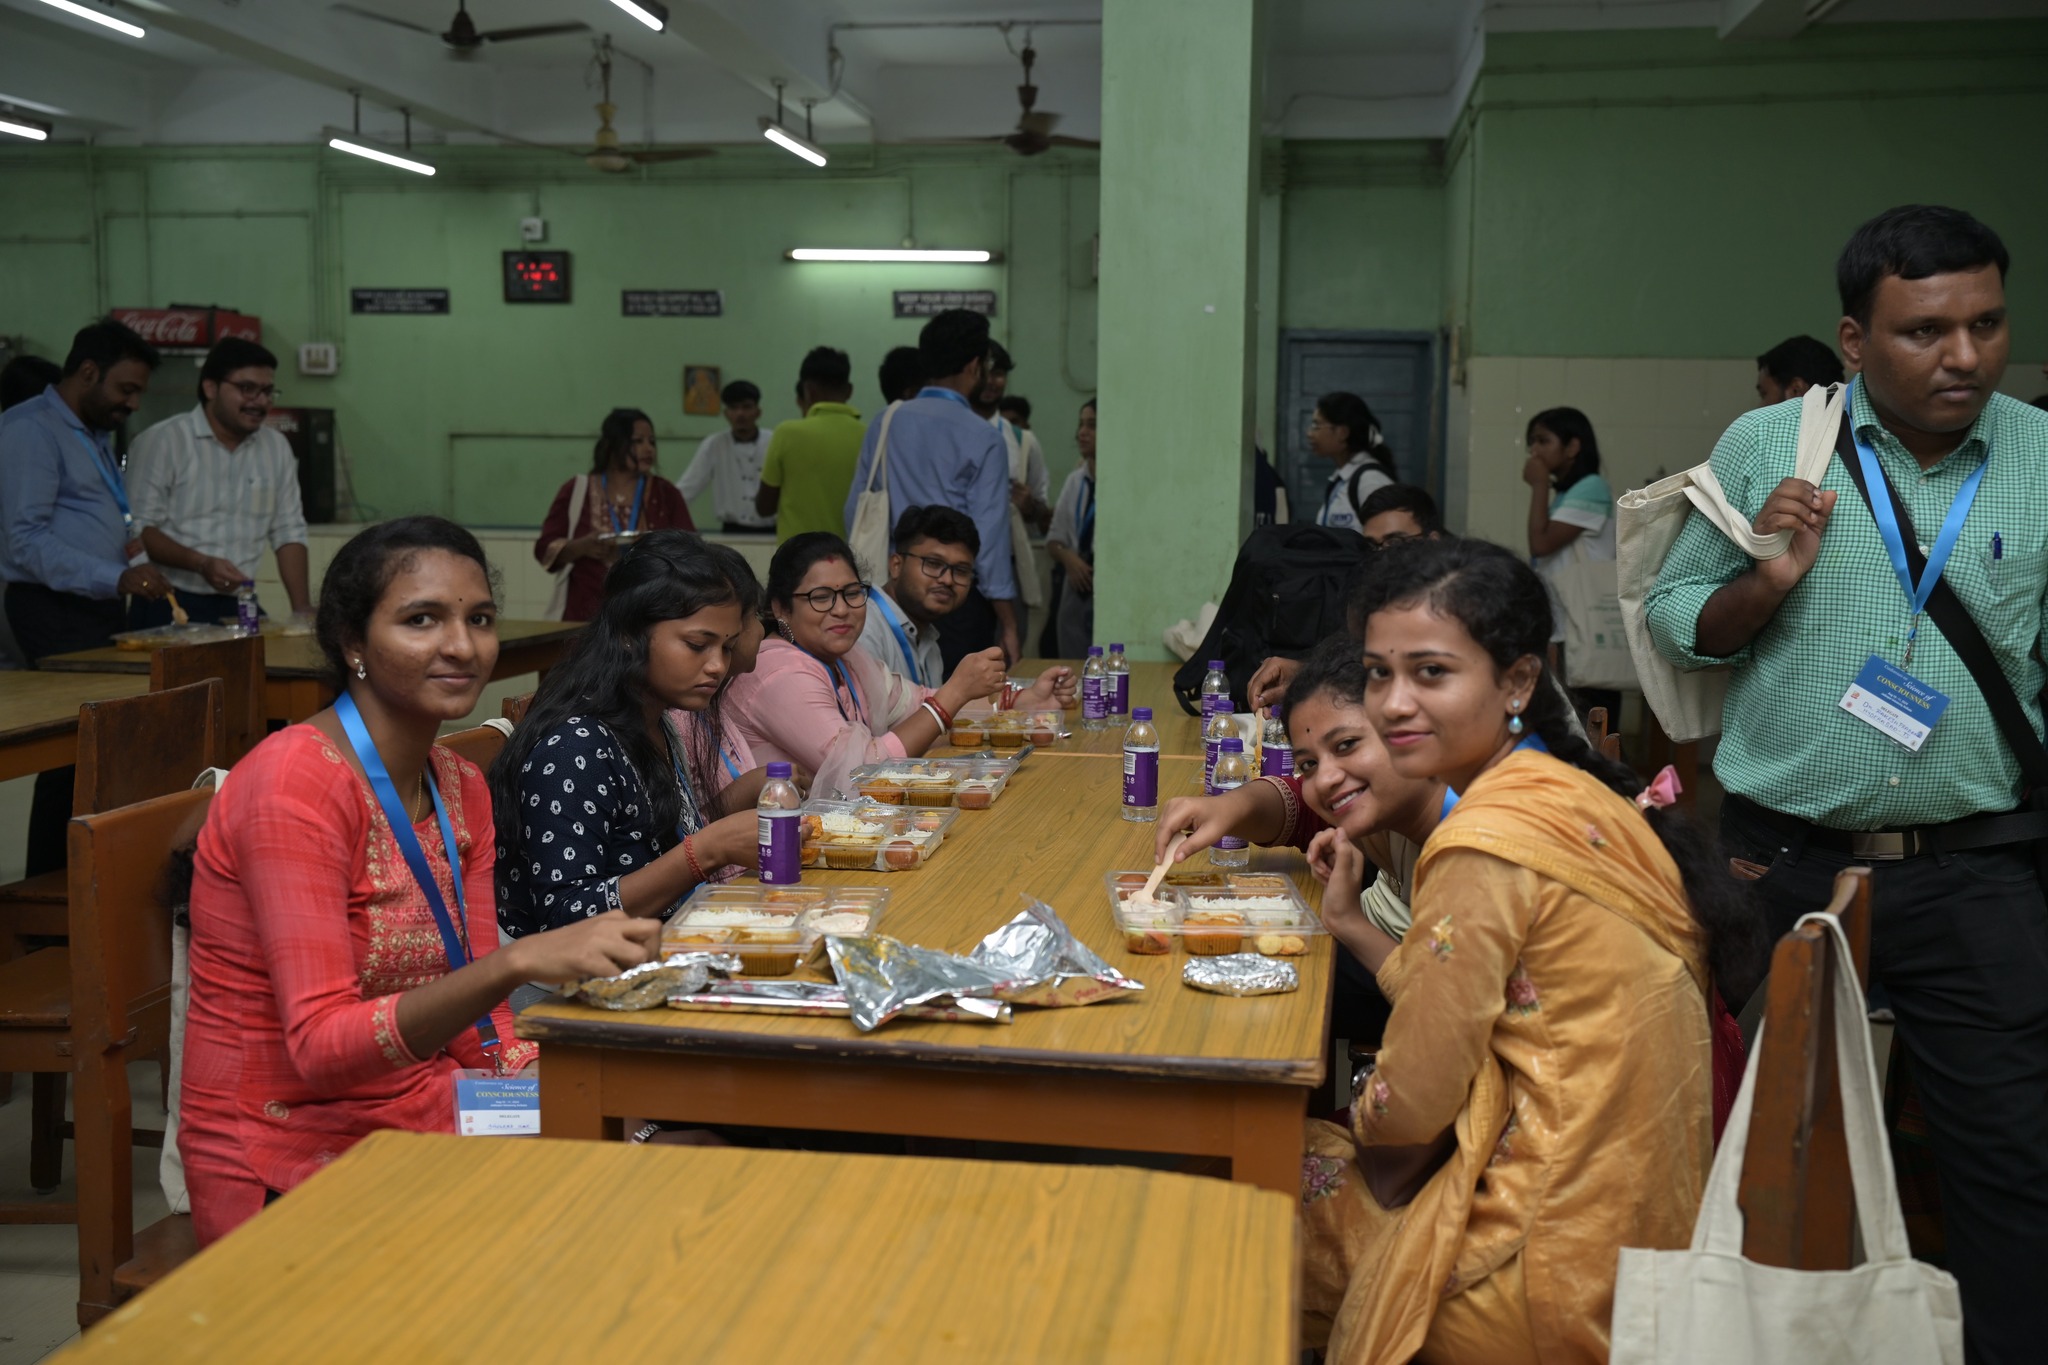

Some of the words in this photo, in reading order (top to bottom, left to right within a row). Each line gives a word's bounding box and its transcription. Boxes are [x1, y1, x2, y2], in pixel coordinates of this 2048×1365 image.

[1876, 674, 1931, 710] CONSCIOUSNESS
[1903, 680, 1925, 696] Science
[1923, 694, 1937, 702] of
